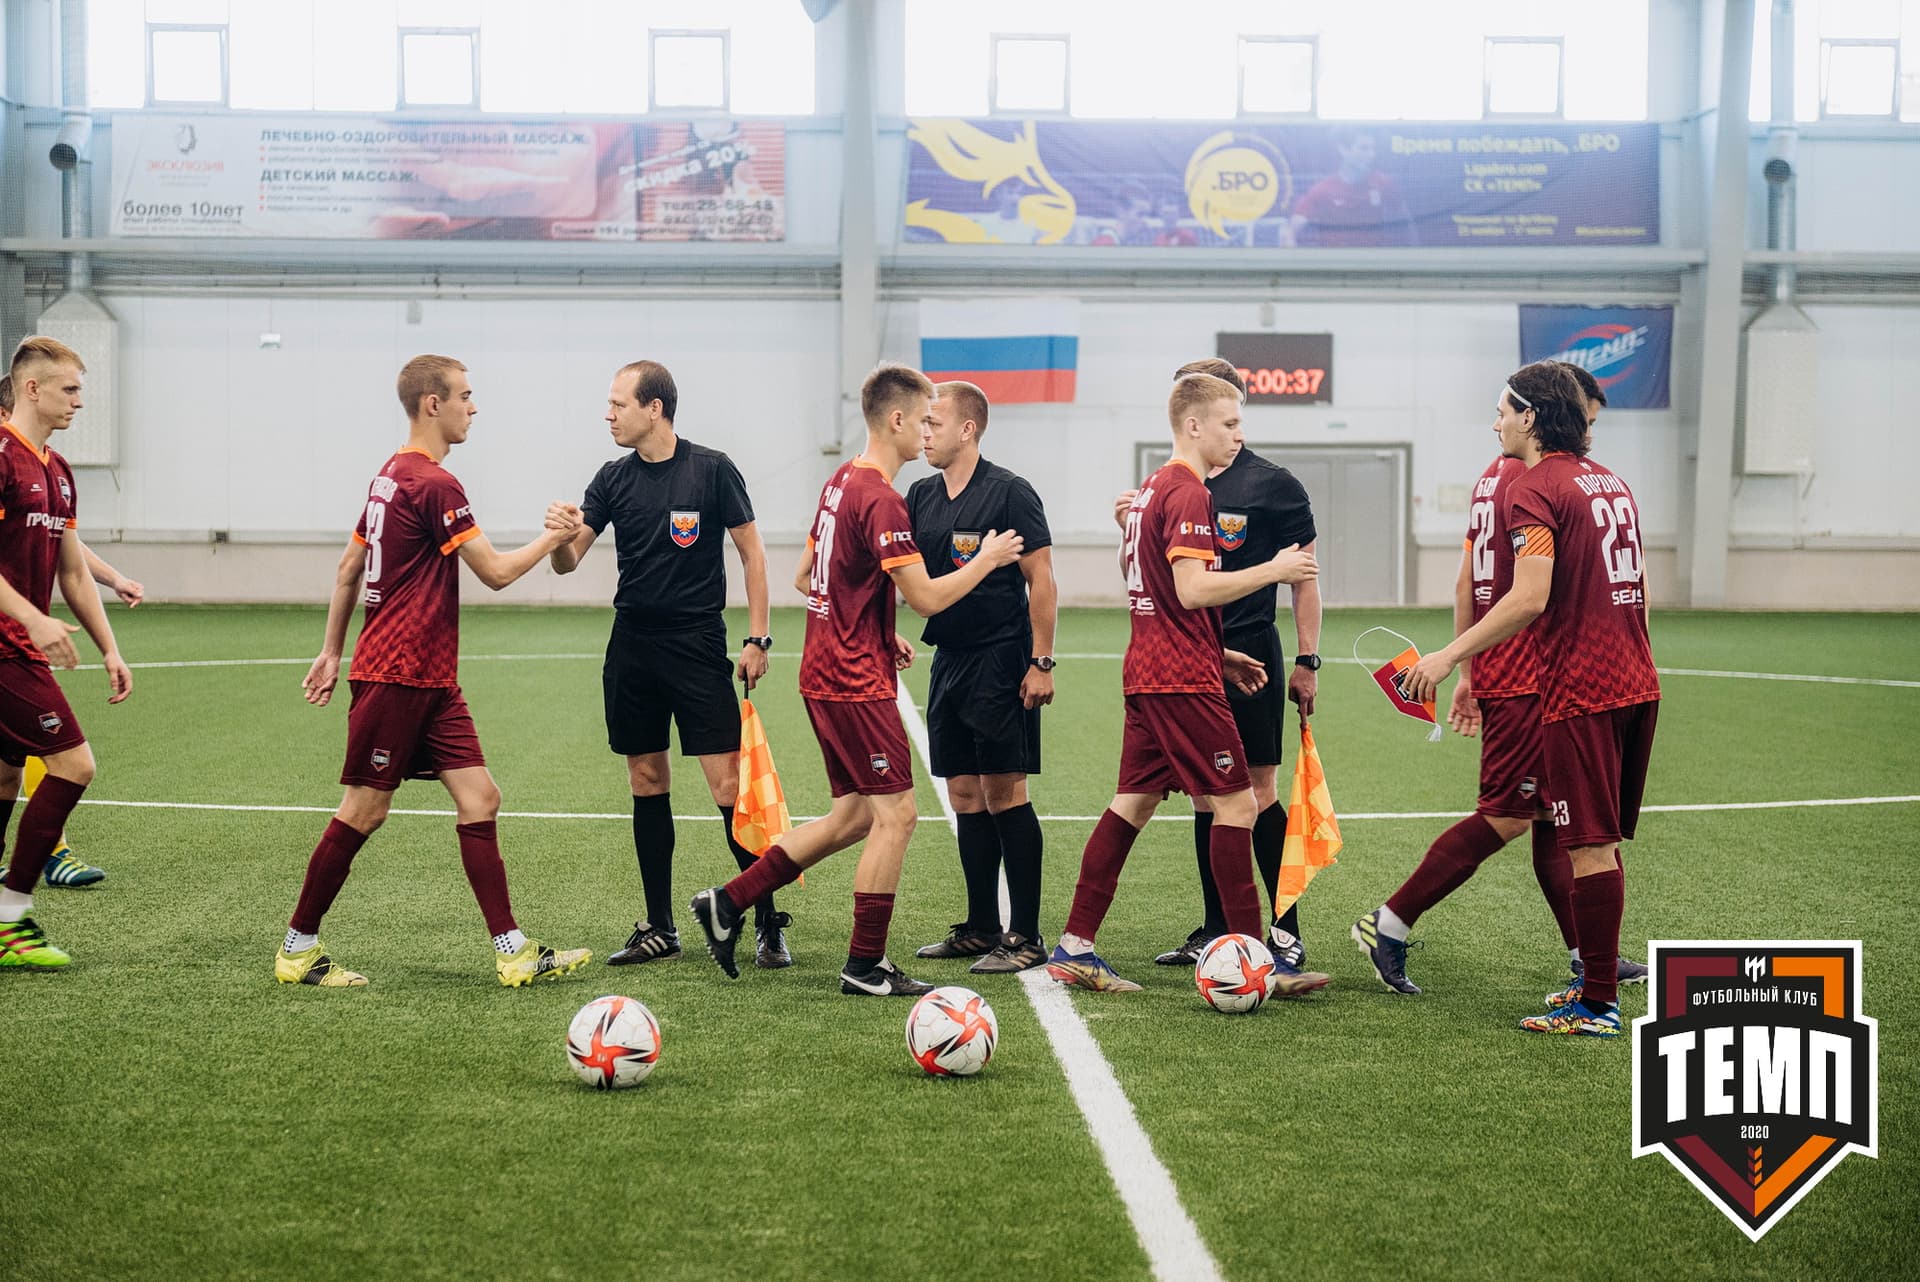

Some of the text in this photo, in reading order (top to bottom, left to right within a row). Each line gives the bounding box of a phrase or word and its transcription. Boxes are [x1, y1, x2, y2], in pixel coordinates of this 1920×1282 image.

[260, 168, 336, 182] ДЕТСКИЙ
[123, 200, 182, 216] более
[1591, 497, 1643, 584] 23
